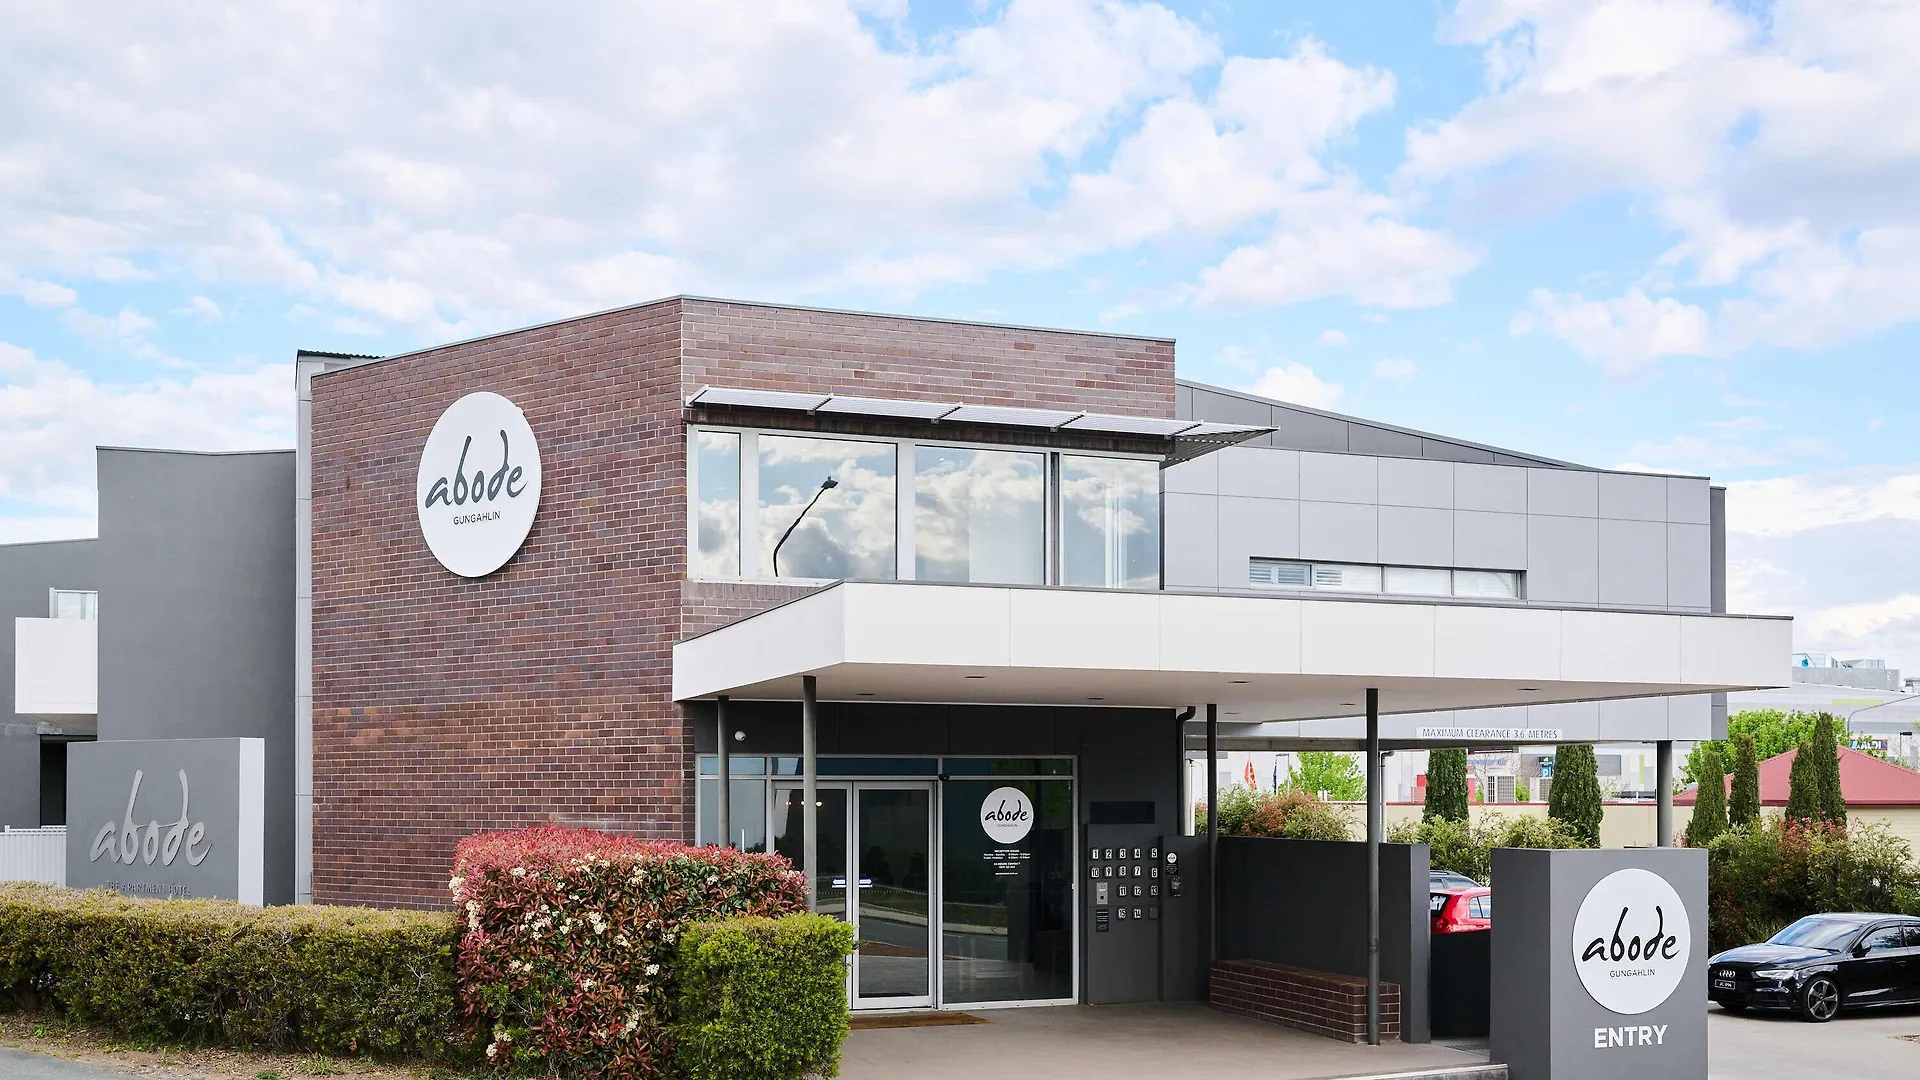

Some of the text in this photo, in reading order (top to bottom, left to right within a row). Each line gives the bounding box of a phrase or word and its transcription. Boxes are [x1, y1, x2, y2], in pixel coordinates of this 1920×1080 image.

[425, 429, 528, 509] abode
[453, 511, 501, 525] GUNGAHLIN
[1422, 728, 1464, 738] MAXIMUM
[1466, 729, 1510, 738] CLEARANCE
[1528, 730, 1558, 739] METRES
[985, 799, 1029, 821] abode
[89, 769, 213, 866] abode
[1106, 849, 1112, 859] 2
[1120, 848, 1126, 859] 3
[1091, 867, 1099, 878] 10
[1106, 866, 1112, 876] 9
[1152, 868, 1157, 878] 6
[122, 882, 166, 894] APARTMENT
[169, 884, 191, 896] HOTEL
[1120, 885, 1126, 896] 11
[1135, 886, 1141, 896] 12
[1151, 885, 1158, 896] 13
[1582, 905, 1681, 963] abode
[1609, 968, 1656, 978] GUNGAHLIN
[1594, 1024, 1668, 1049] ENTRY
